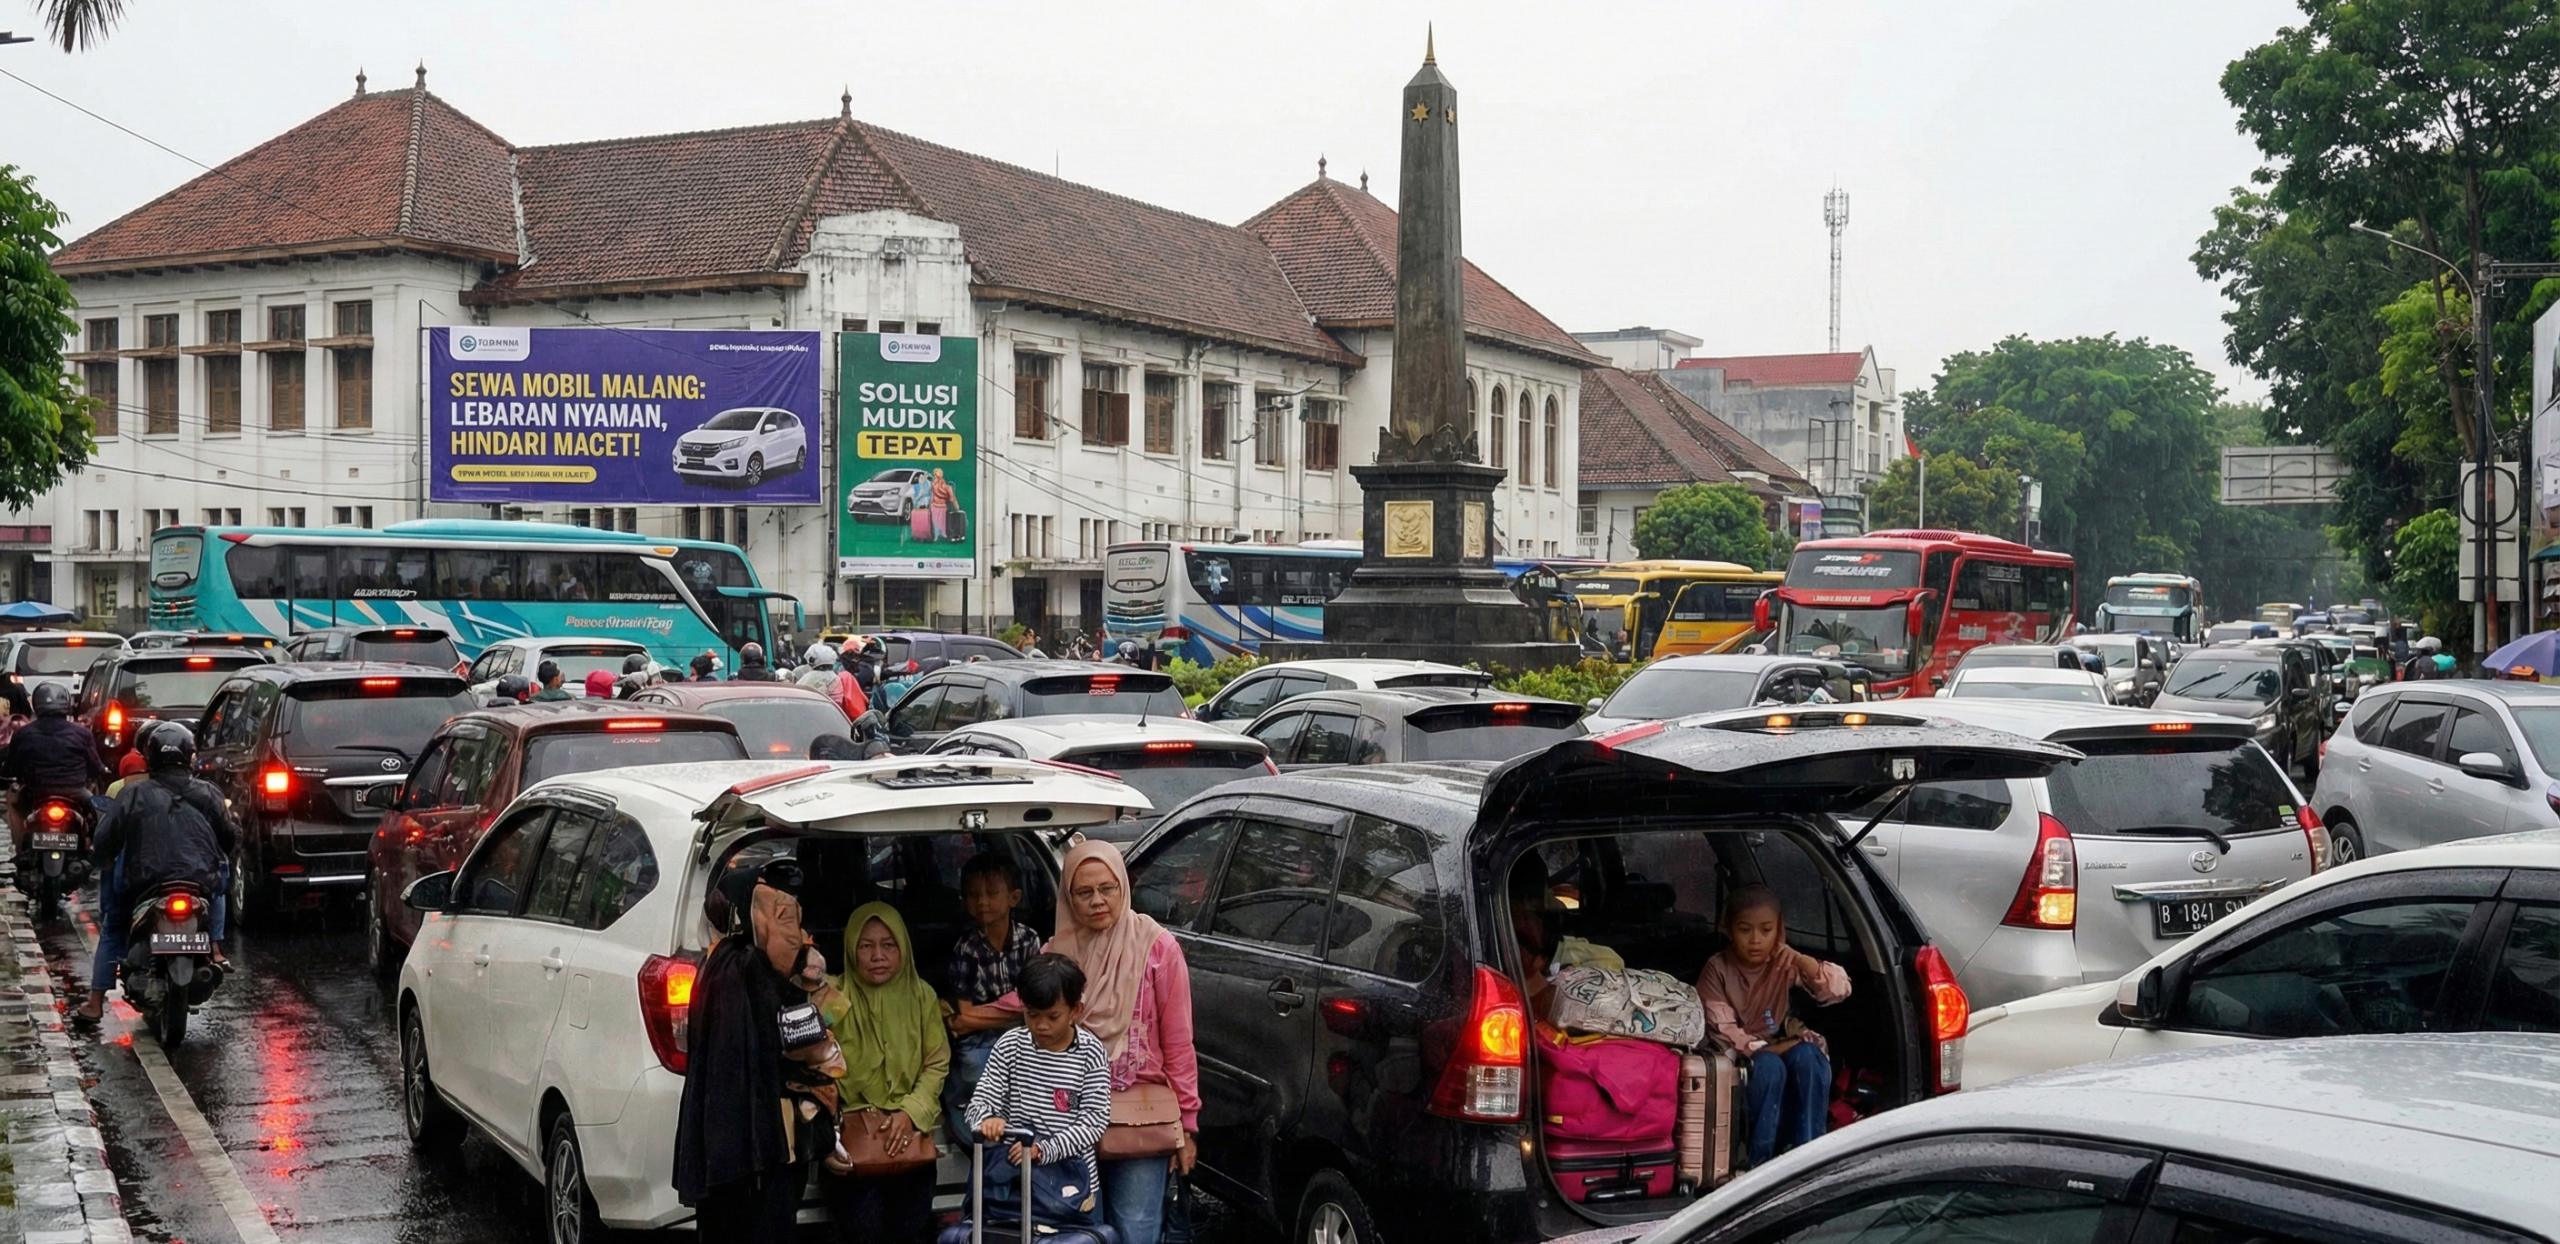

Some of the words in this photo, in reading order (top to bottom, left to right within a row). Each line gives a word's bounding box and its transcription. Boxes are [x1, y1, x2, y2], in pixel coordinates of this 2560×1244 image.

[450, 372, 516, 397] SEWA
[523, 373, 596, 398] MOBIL
[602, 374, 706, 399] MALANG:
[859, 382, 958, 406] SOLUSI
[451, 402, 557, 427] LEBARAN
[564, 403, 668, 432] NYAMAN,
[862, 407, 956, 430] MUDIK
[451, 431, 547, 456] HINDARI
[554, 432, 641, 457] MACET!
[866, 435, 953, 456] TEPAT
[2162, 905, 2170, 923] B
[2184, 903, 2214, 922] 1841
